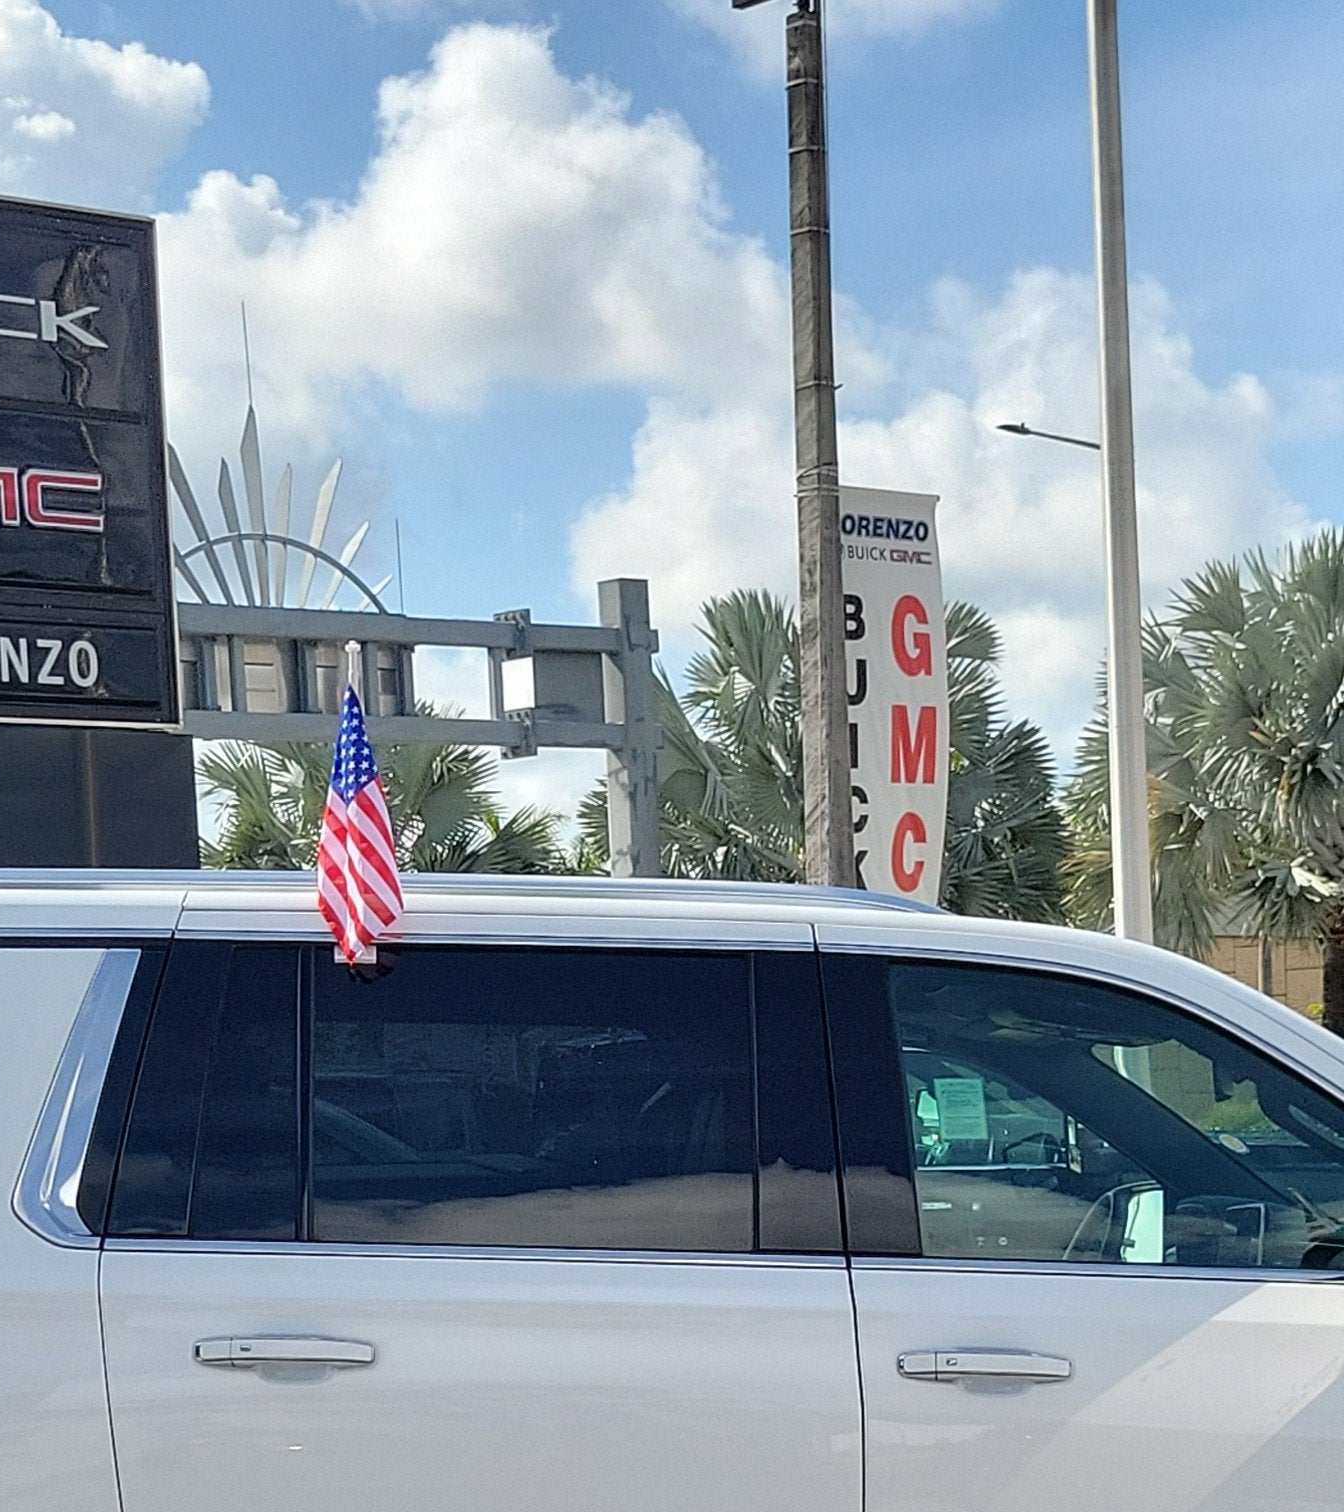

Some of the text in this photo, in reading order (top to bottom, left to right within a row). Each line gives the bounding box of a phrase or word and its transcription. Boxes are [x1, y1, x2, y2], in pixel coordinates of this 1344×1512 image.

[841, 513, 929, 542] ORENZO
[847, 545, 932, 565] BUICK GMC
[890, 594, 937, 893] GMC
